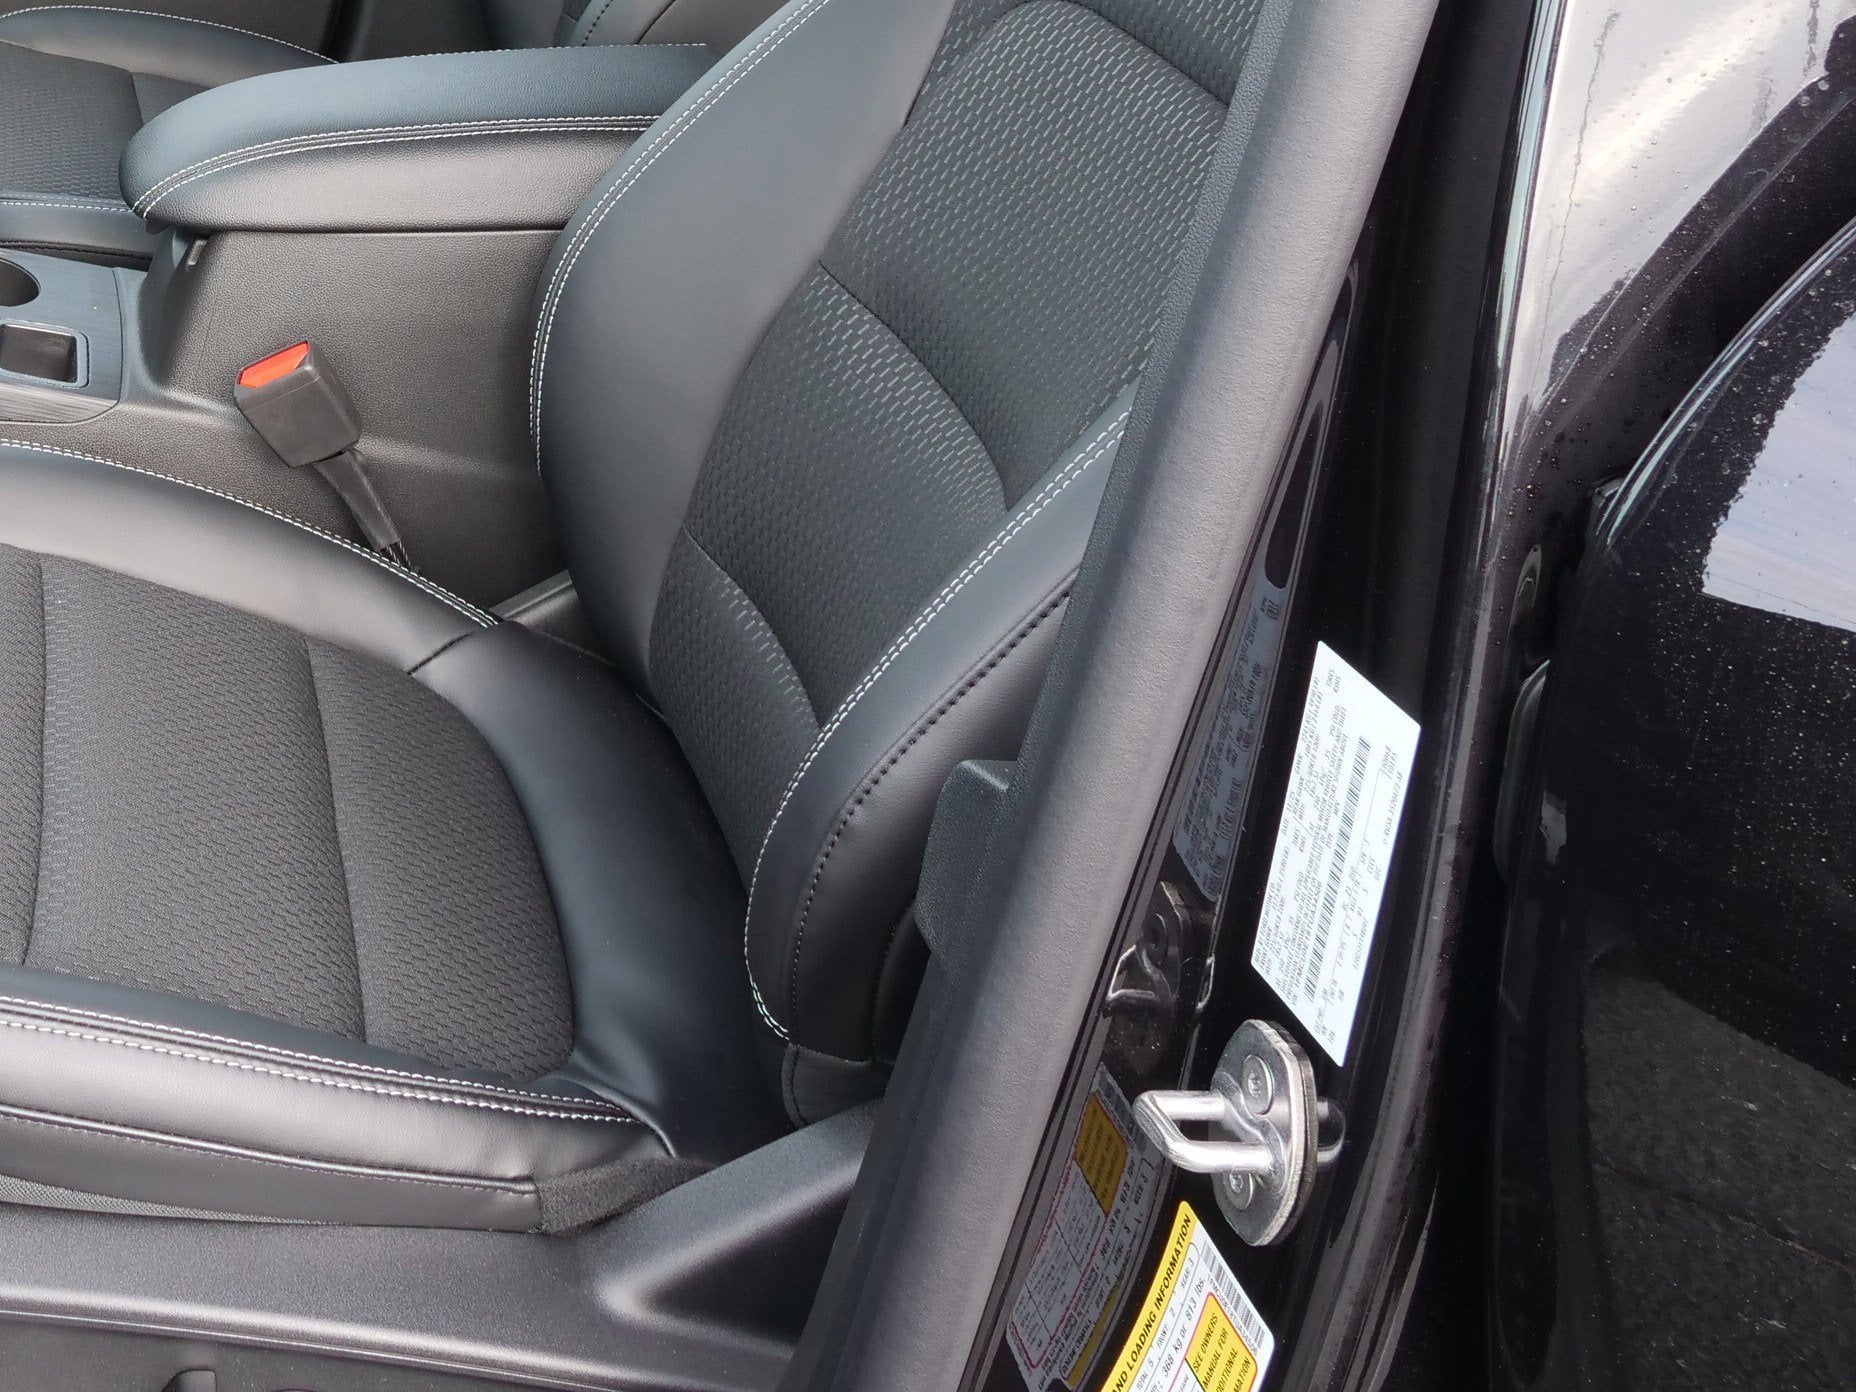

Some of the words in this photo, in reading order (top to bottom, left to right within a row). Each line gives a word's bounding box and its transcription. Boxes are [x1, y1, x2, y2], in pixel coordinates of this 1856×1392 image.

[1129, 1310, 1158, 1371] LOADING
[1156, 1214, 1191, 1309] INFORMATION
[1170, 1308, 1176, 1318] 2
[1162, 1353, 1174, 1377] 368
[1173, 1337, 1182, 1354] kg
[1180, 1325, 1187, 1338] or
[1186, 1298, 1197, 1322] 813
[1193, 1353, 1204, 1372] SEE
[1202, 1313, 1218, 1353] OWNERS
[1202, 1347, 1223, 1389] MANUAL
[1218, 1327, 1229, 1348] FOR
[1217, 1349, 1239, 1392] DDITIONAL
